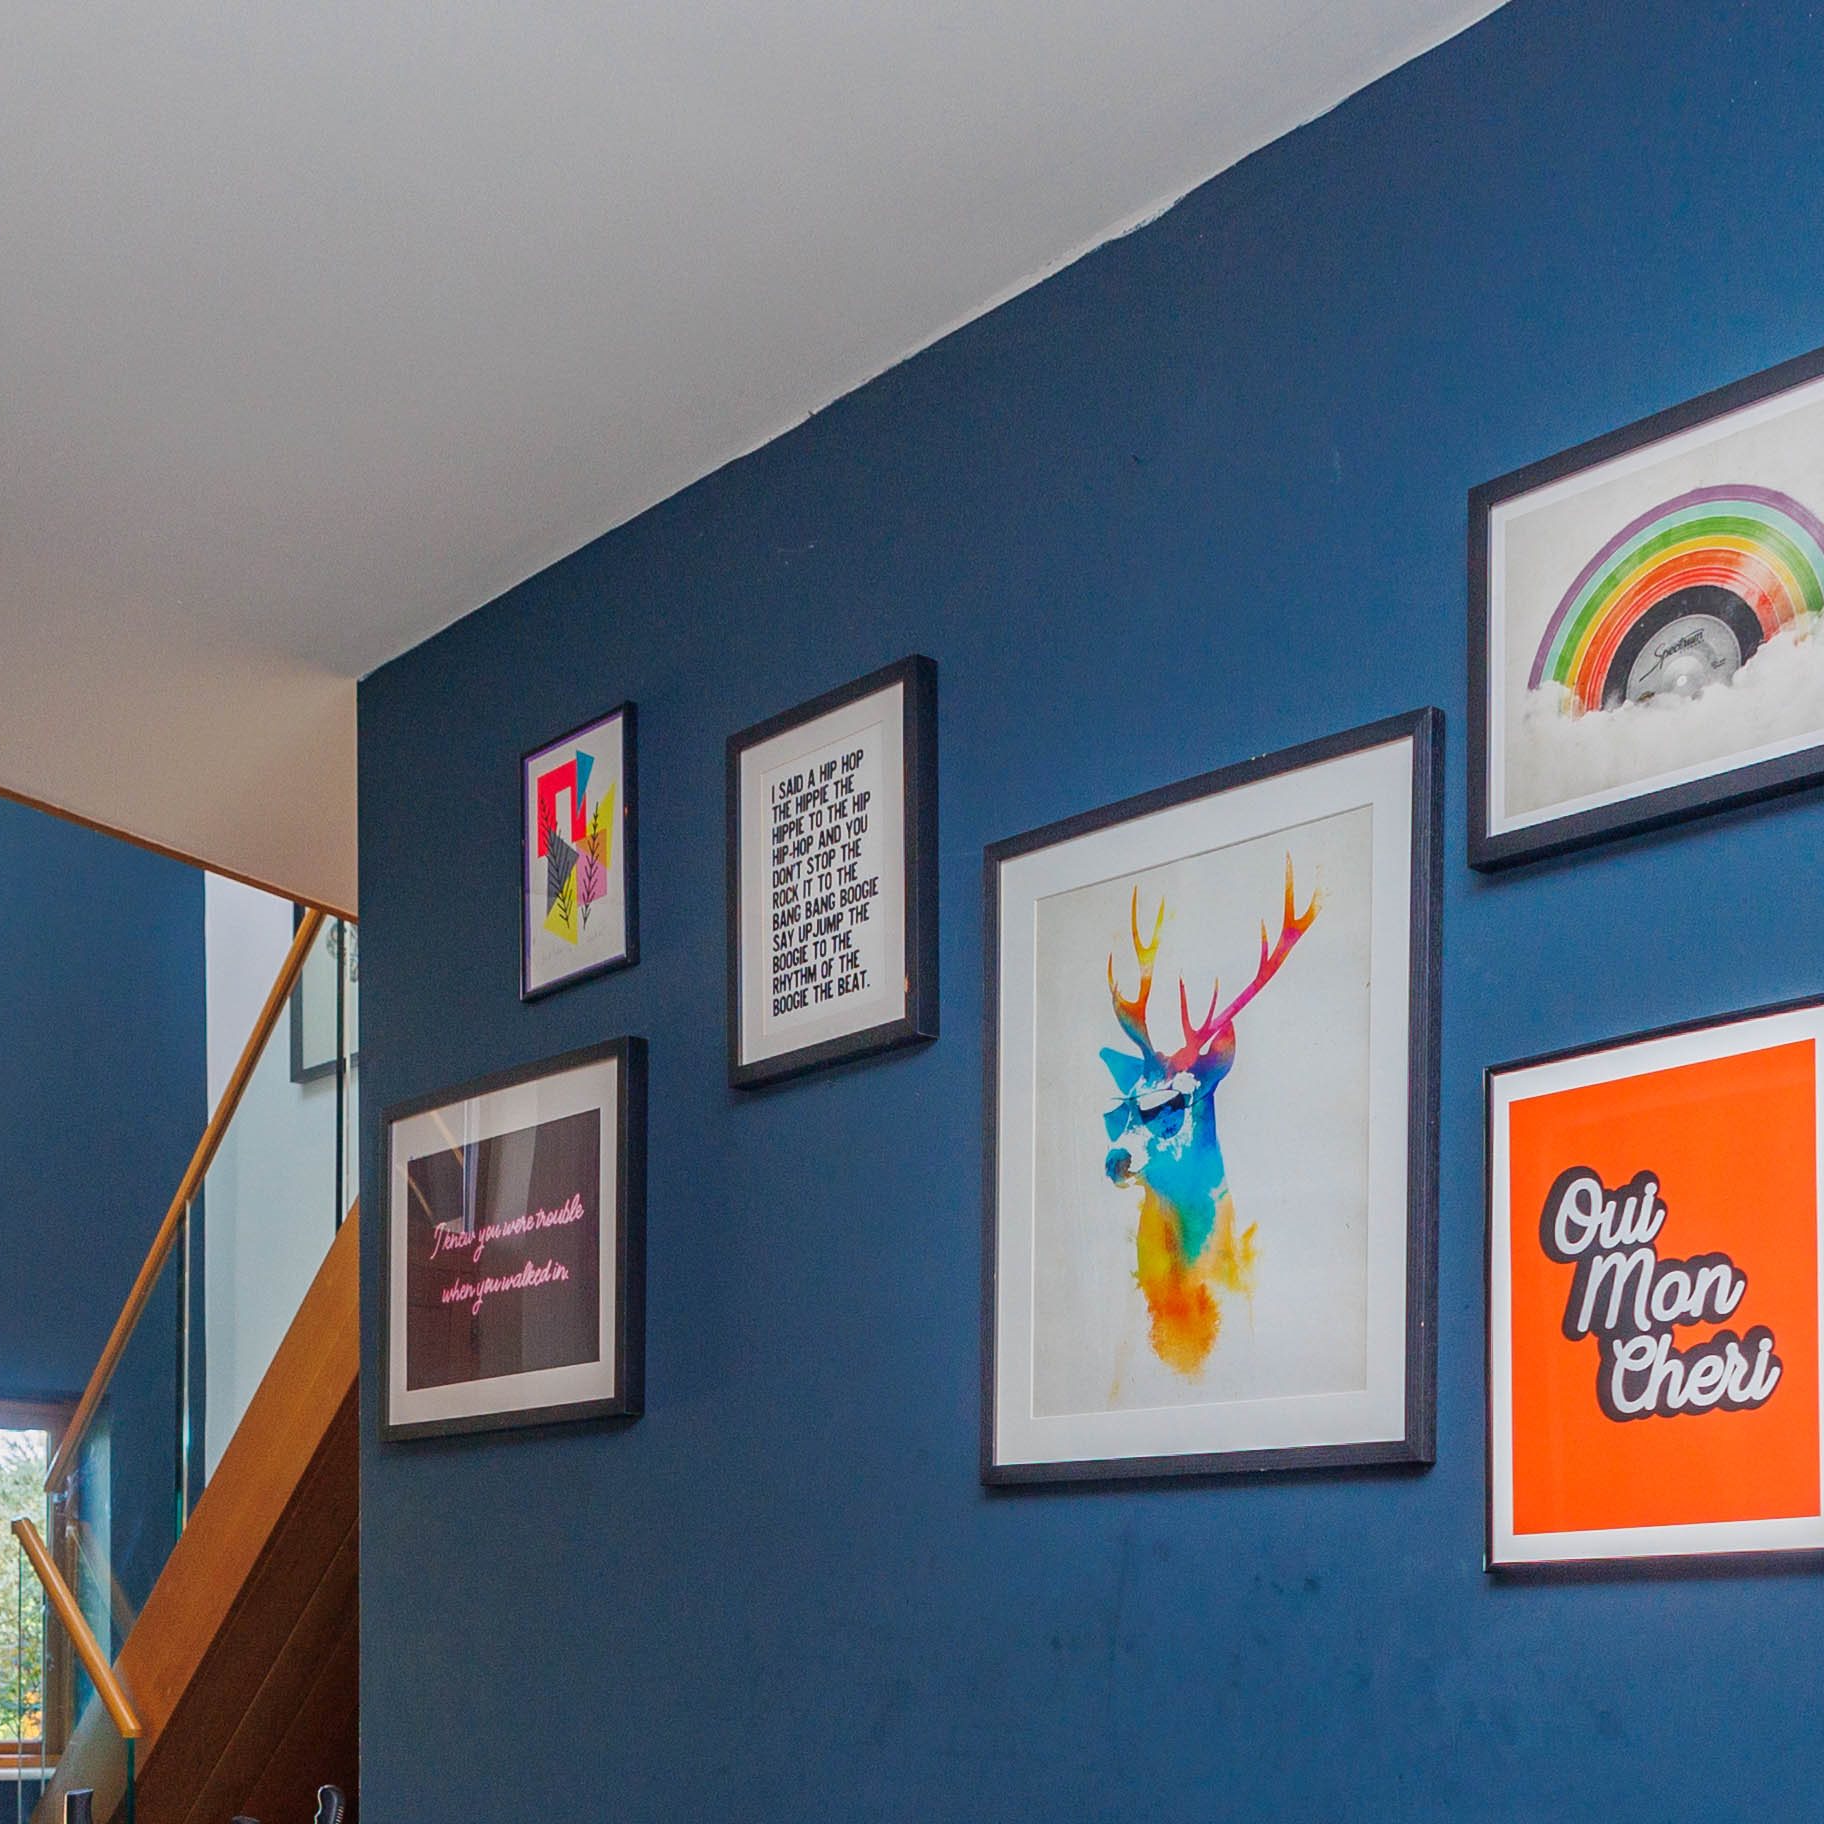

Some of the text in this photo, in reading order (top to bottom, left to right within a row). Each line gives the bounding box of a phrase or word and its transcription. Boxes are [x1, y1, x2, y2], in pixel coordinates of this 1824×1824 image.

[771, 749, 864, 804] I SAID A HIP HOP
[772, 774, 855, 824] THE HIPPIE THE
[772, 791, 871, 846] HIPPIE TO THE HIP
[772, 814, 868, 867] HIP-HOP AND YOU
[772, 837, 862, 889] DON'T STOP THE
[772, 861, 858, 910] ROCK IT TO THE
[772, 876, 879, 931] BANG BANG BOOGIE
[772, 928, 795, 952] SAY
[848, 901, 870, 926] THE
[772, 929, 853, 974] BOOGIE TO THE
[772, 949, 860, 995] RHYTHM OF THE
[772, 969, 871, 1017] BOOGIE THE BEAT.
[441, 1229, 476, 1250] knew
[473, 1224, 502, 1263] you
[502, 1215, 536, 1237] were
[535, 1192, 585, 1230] trouble
[1553, 1175, 1666, 1257] Oui
[441, 1277, 475, 1303] when
[471, 1277, 502, 1316] you
[501, 1258, 552, 1291] walked
[1576, 1248, 1746, 1335] Mon
[1609, 1332, 1783, 1415] Cheri
